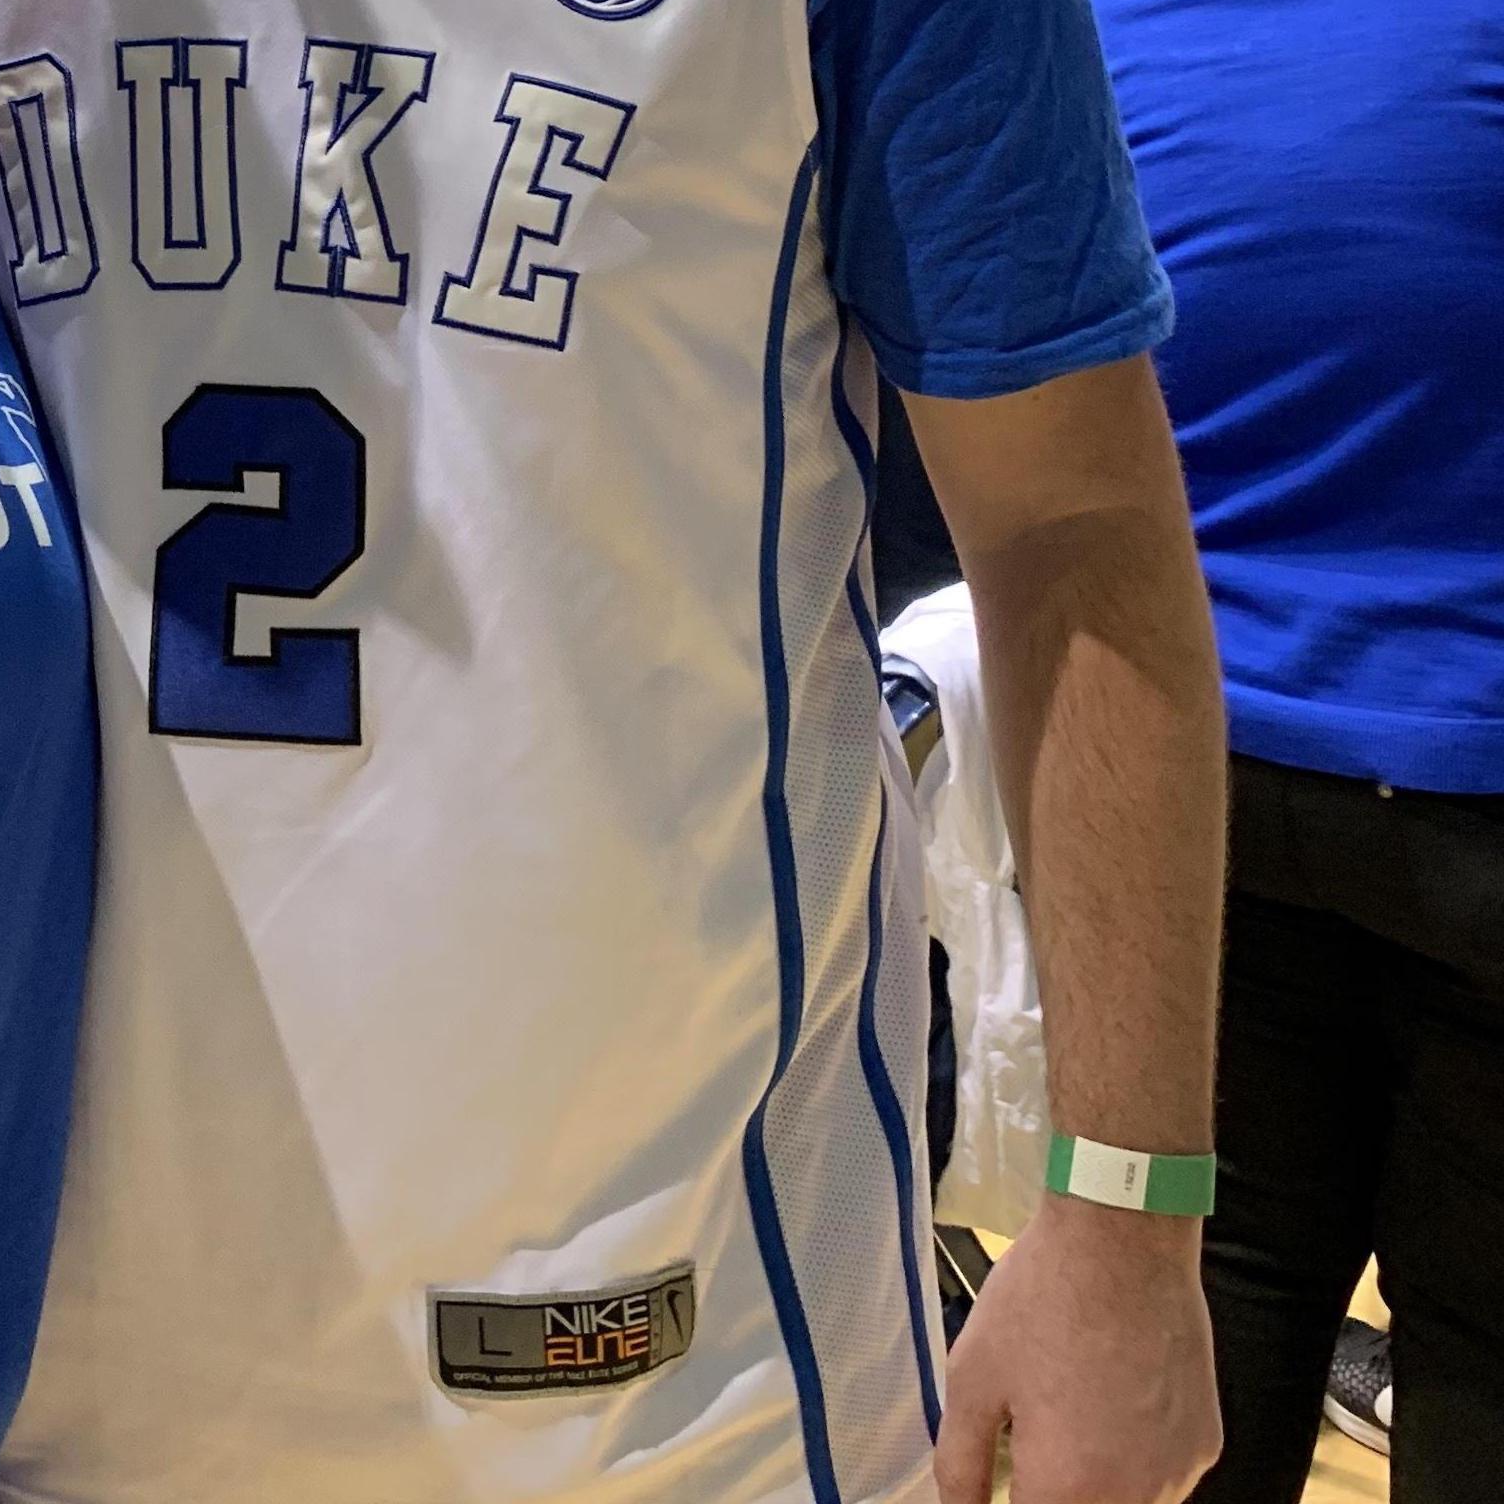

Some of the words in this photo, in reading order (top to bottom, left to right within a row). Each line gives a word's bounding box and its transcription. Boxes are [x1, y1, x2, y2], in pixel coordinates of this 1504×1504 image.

[148, 382, 367, 746] 2
[545, 1294, 649, 1336] NIKE
[478, 1316, 513, 1357] L
[546, 1324, 649, 1366] ELITE
